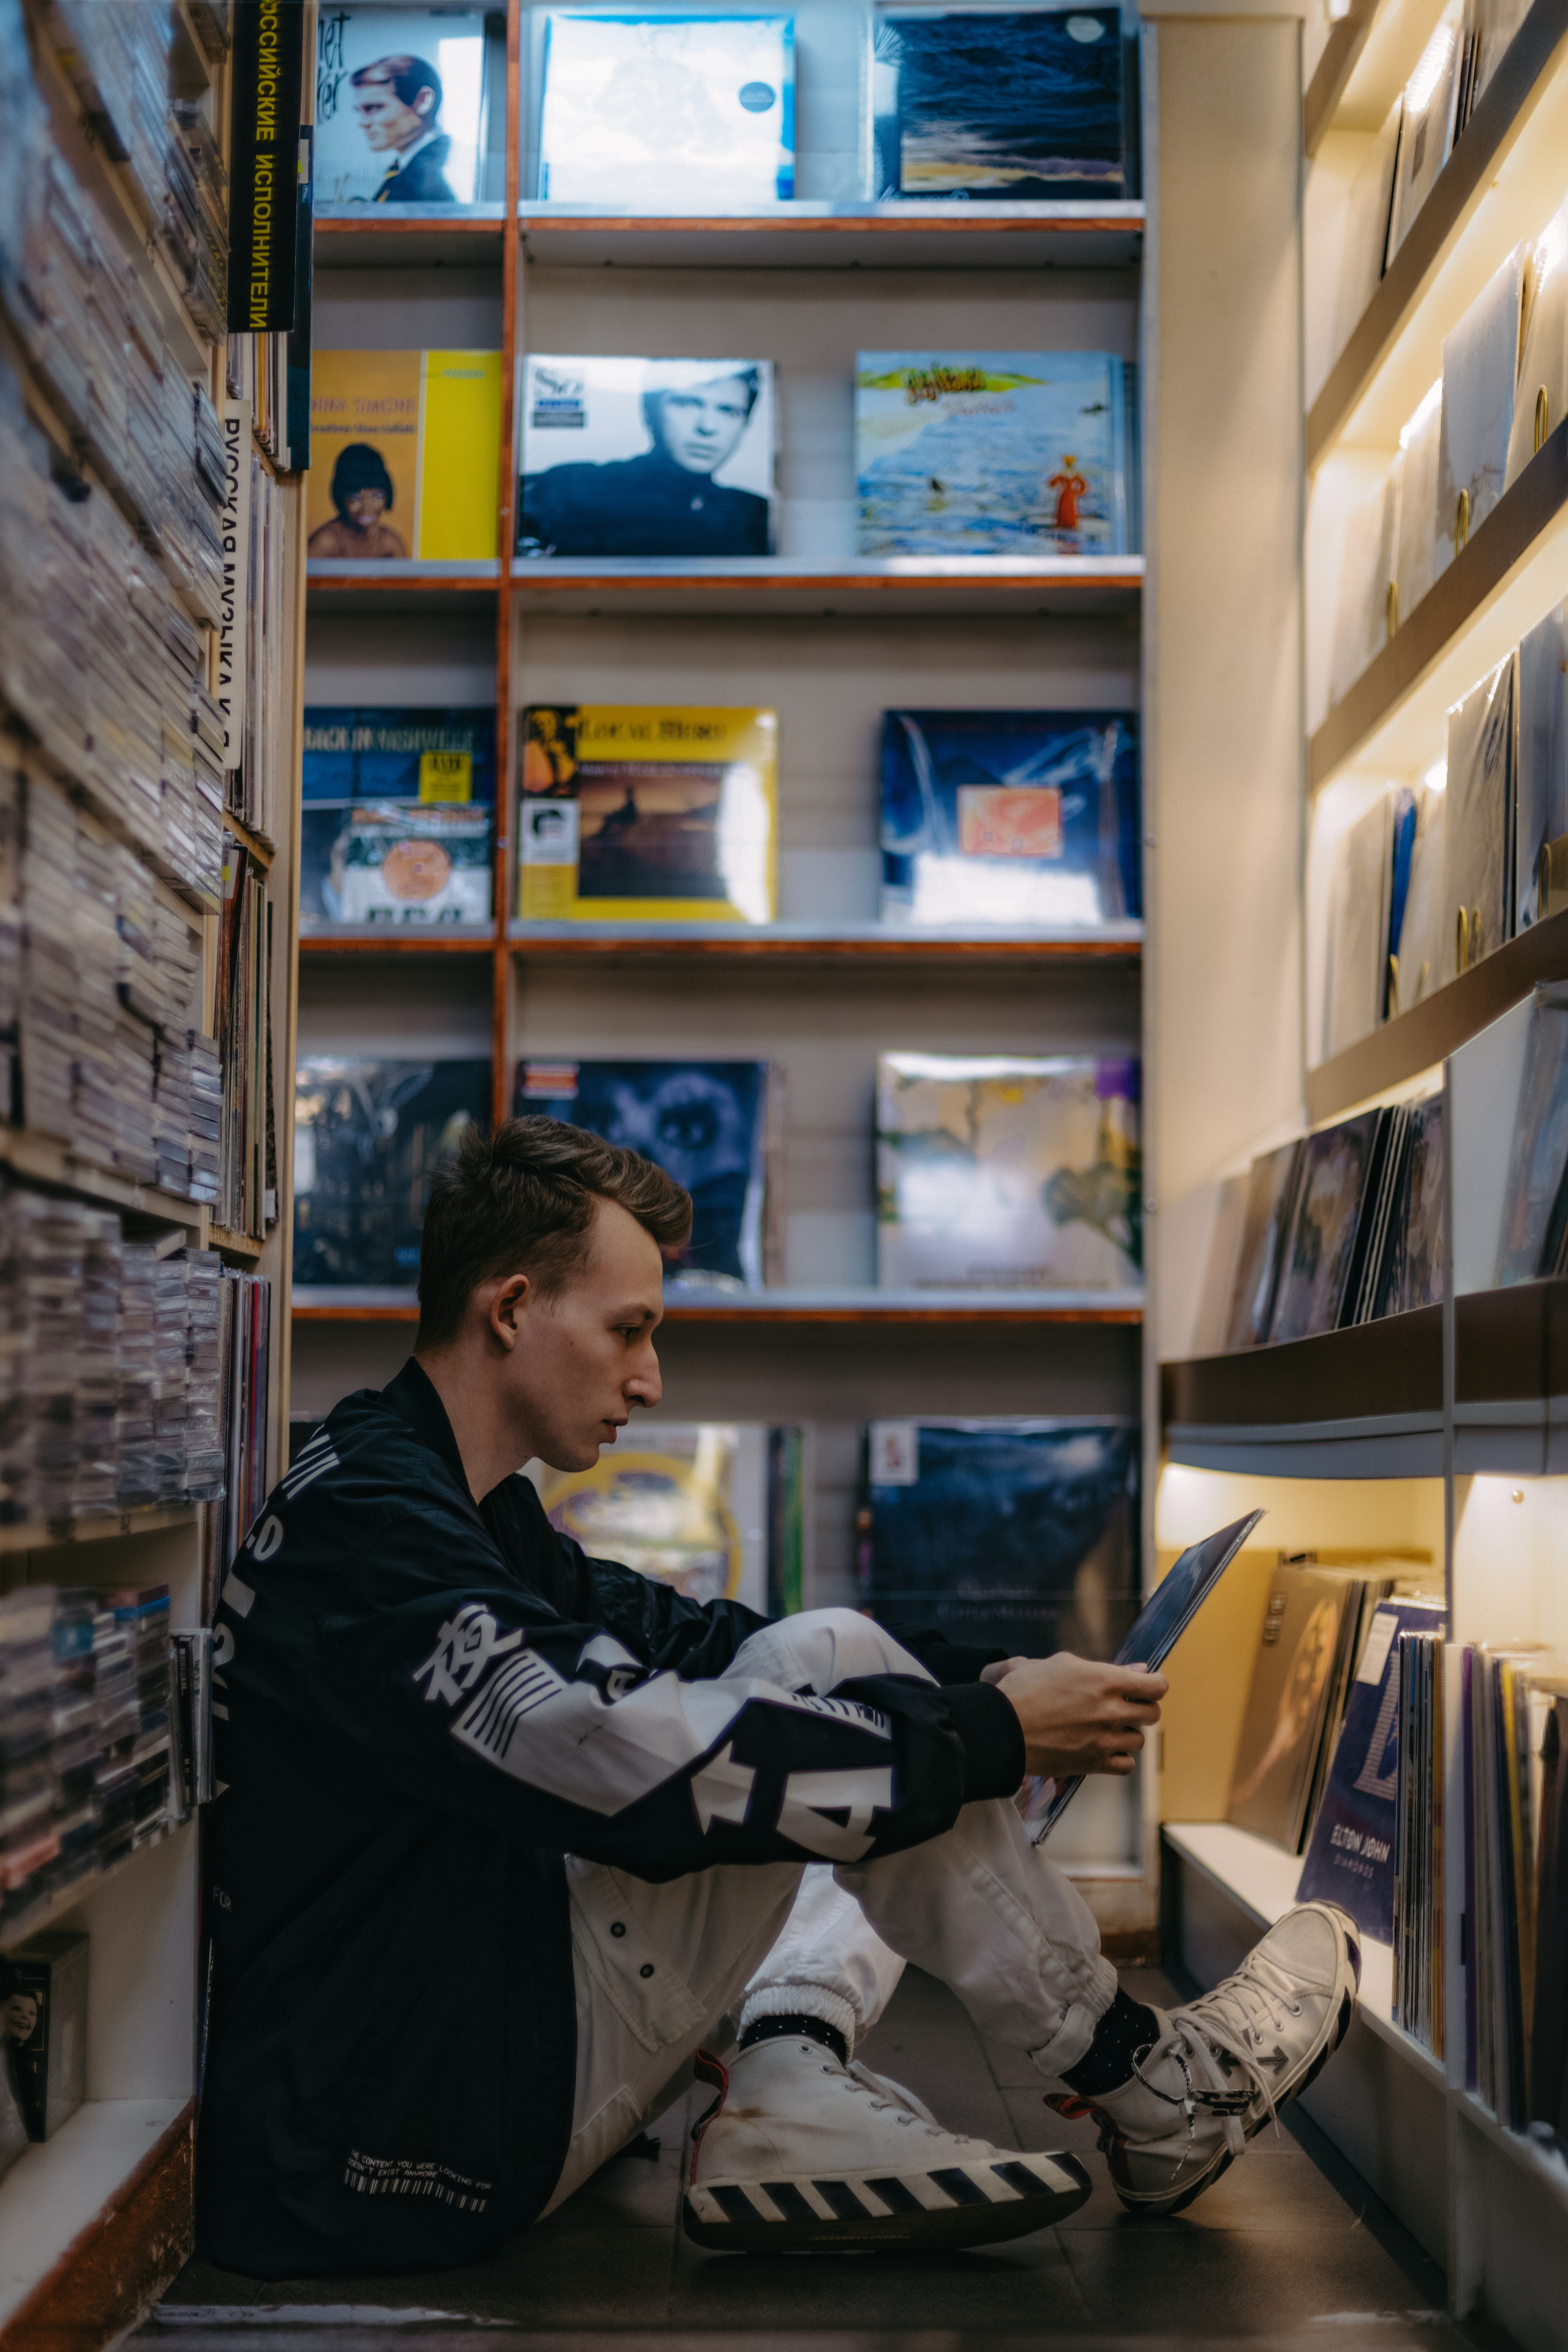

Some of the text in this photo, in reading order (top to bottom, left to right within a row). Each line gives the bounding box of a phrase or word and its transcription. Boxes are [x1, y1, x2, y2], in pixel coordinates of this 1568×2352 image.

[249, 154, 273, 328] ИСПОЛНИТЕЛИ
[1330, 1823, 1391, 1864] ELTON JOHN
[347, 2157, 438, 2179] DOESN'T EXIST ANYMORE
[361, 2155, 393, 2168] CONTENT
[397, 2160, 413, 2169] YOU
[439, 2165, 472, 2186] LOOKING
[475, 2182, 492, 2190] FOR
